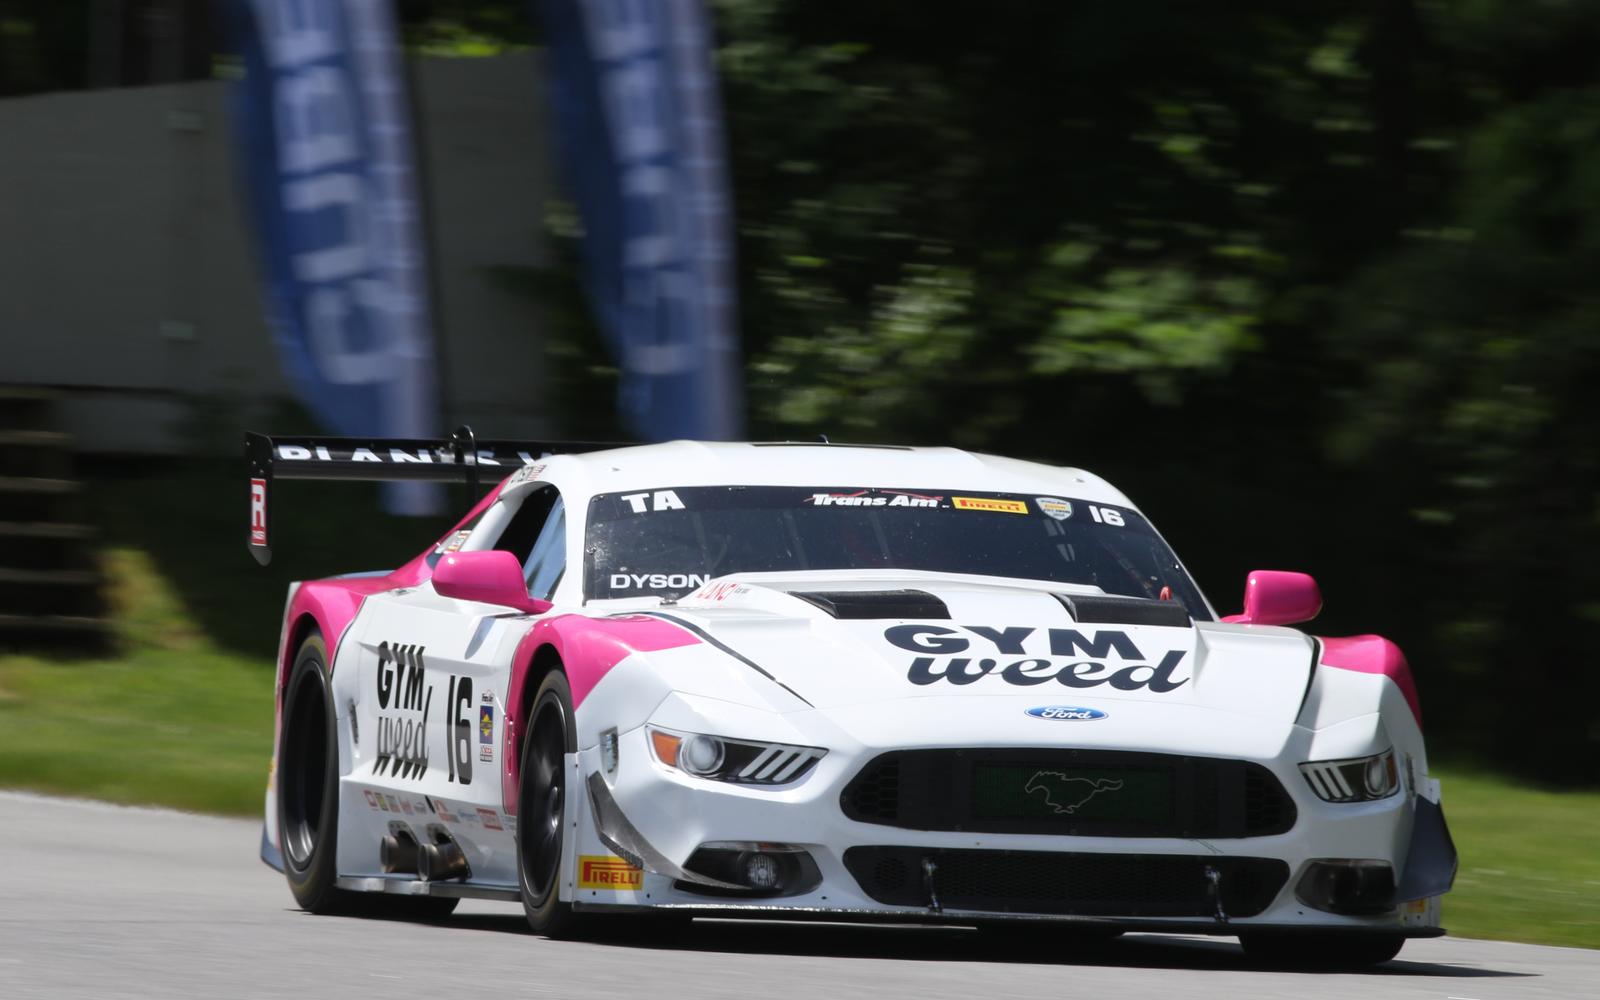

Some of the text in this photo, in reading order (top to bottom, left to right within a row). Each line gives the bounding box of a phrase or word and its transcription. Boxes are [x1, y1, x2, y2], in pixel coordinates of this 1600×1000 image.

[622, 490, 685, 513] TA
[812, 494, 938, 508] Trans Am
[960, 499, 1021, 511] PIRELLI
[1088, 505, 1125, 527] 16
[610, 574, 710, 589] DYSON
[884, 624, 1146, 661] GYM
[377, 641, 425, 711] GYM
[907, 650, 1190, 693] weed
[1040, 706, 1092, 719] Ford
[372, 686, 433, 781] weed
[447, 675, 473, 785] 16
[583, 861, 641, 884] PIRELLI
